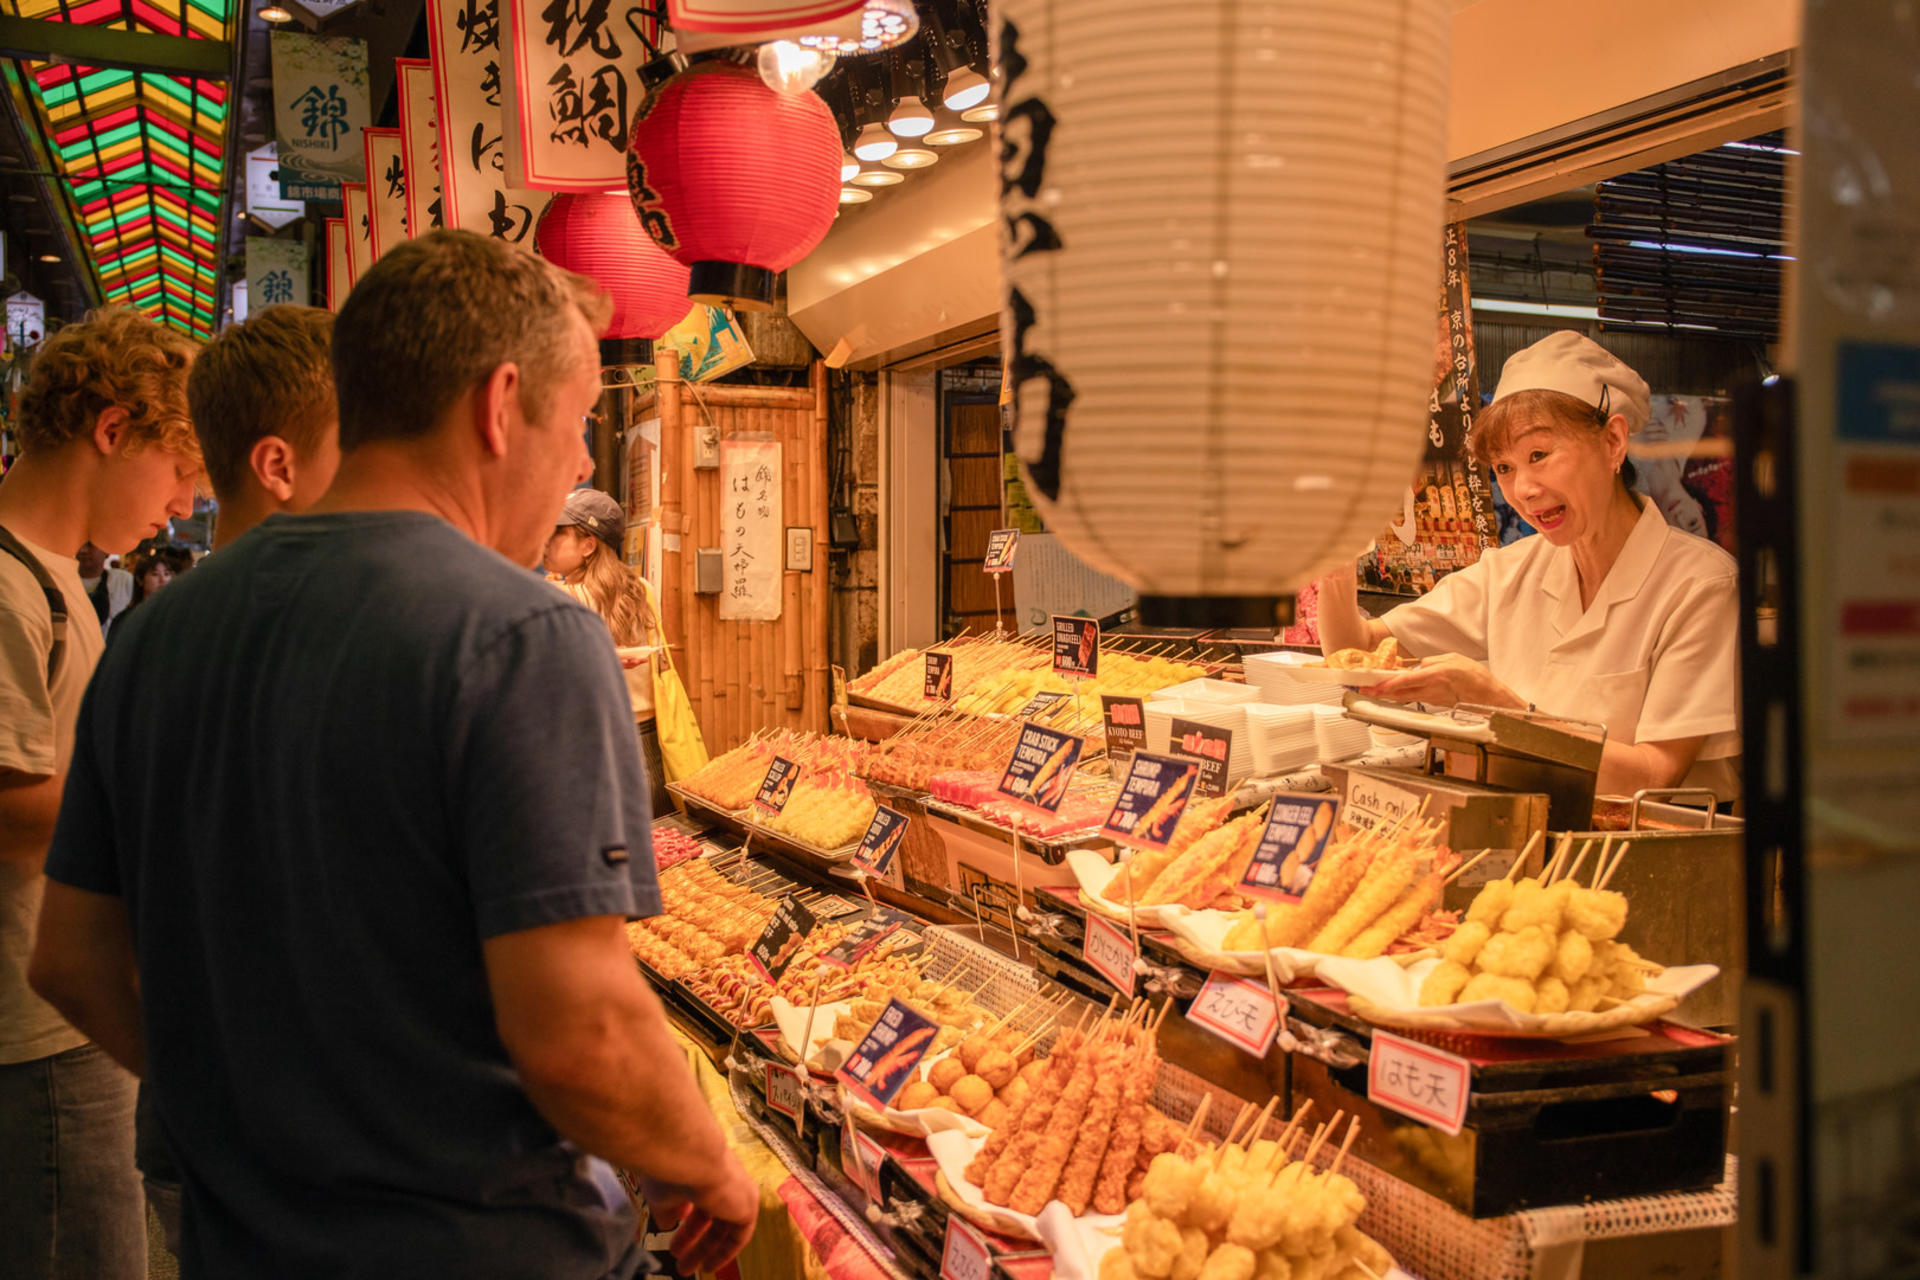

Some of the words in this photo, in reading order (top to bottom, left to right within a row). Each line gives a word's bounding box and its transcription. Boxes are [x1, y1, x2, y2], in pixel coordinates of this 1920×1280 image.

[290, 84, 350, 152] 錦
[291, 138, 330, 150] NISHIKI
[256, 270, 294, 304] 錦
[1056, 621, 1074, 633] GRILLED
[1022, 729, 1041, 748] CRAB
[1038, 733, 1060, 753] STICK
[1108, 726, 1128, 738] KYOTO
[1128, 728, 1144, 740] BEEF
[1017, 744, 1048, 766] TEMPURA
[1133, 759, 1162, 779] SHRIMP
[1200, 759, 1222, 774] BEEF
[1126, 776, 1160, 798] TEMPURA
[1352, 784, 1380, 811] Cash
[1385, 800, 1410, 822] onl
[1297, 805, 1314, 827] EEL
[1264, 822, 1300, 846] TEMPURA
[1207, 985, 1259, 1031] えび天
[1381, 1060, 1447, 1108] はも天
